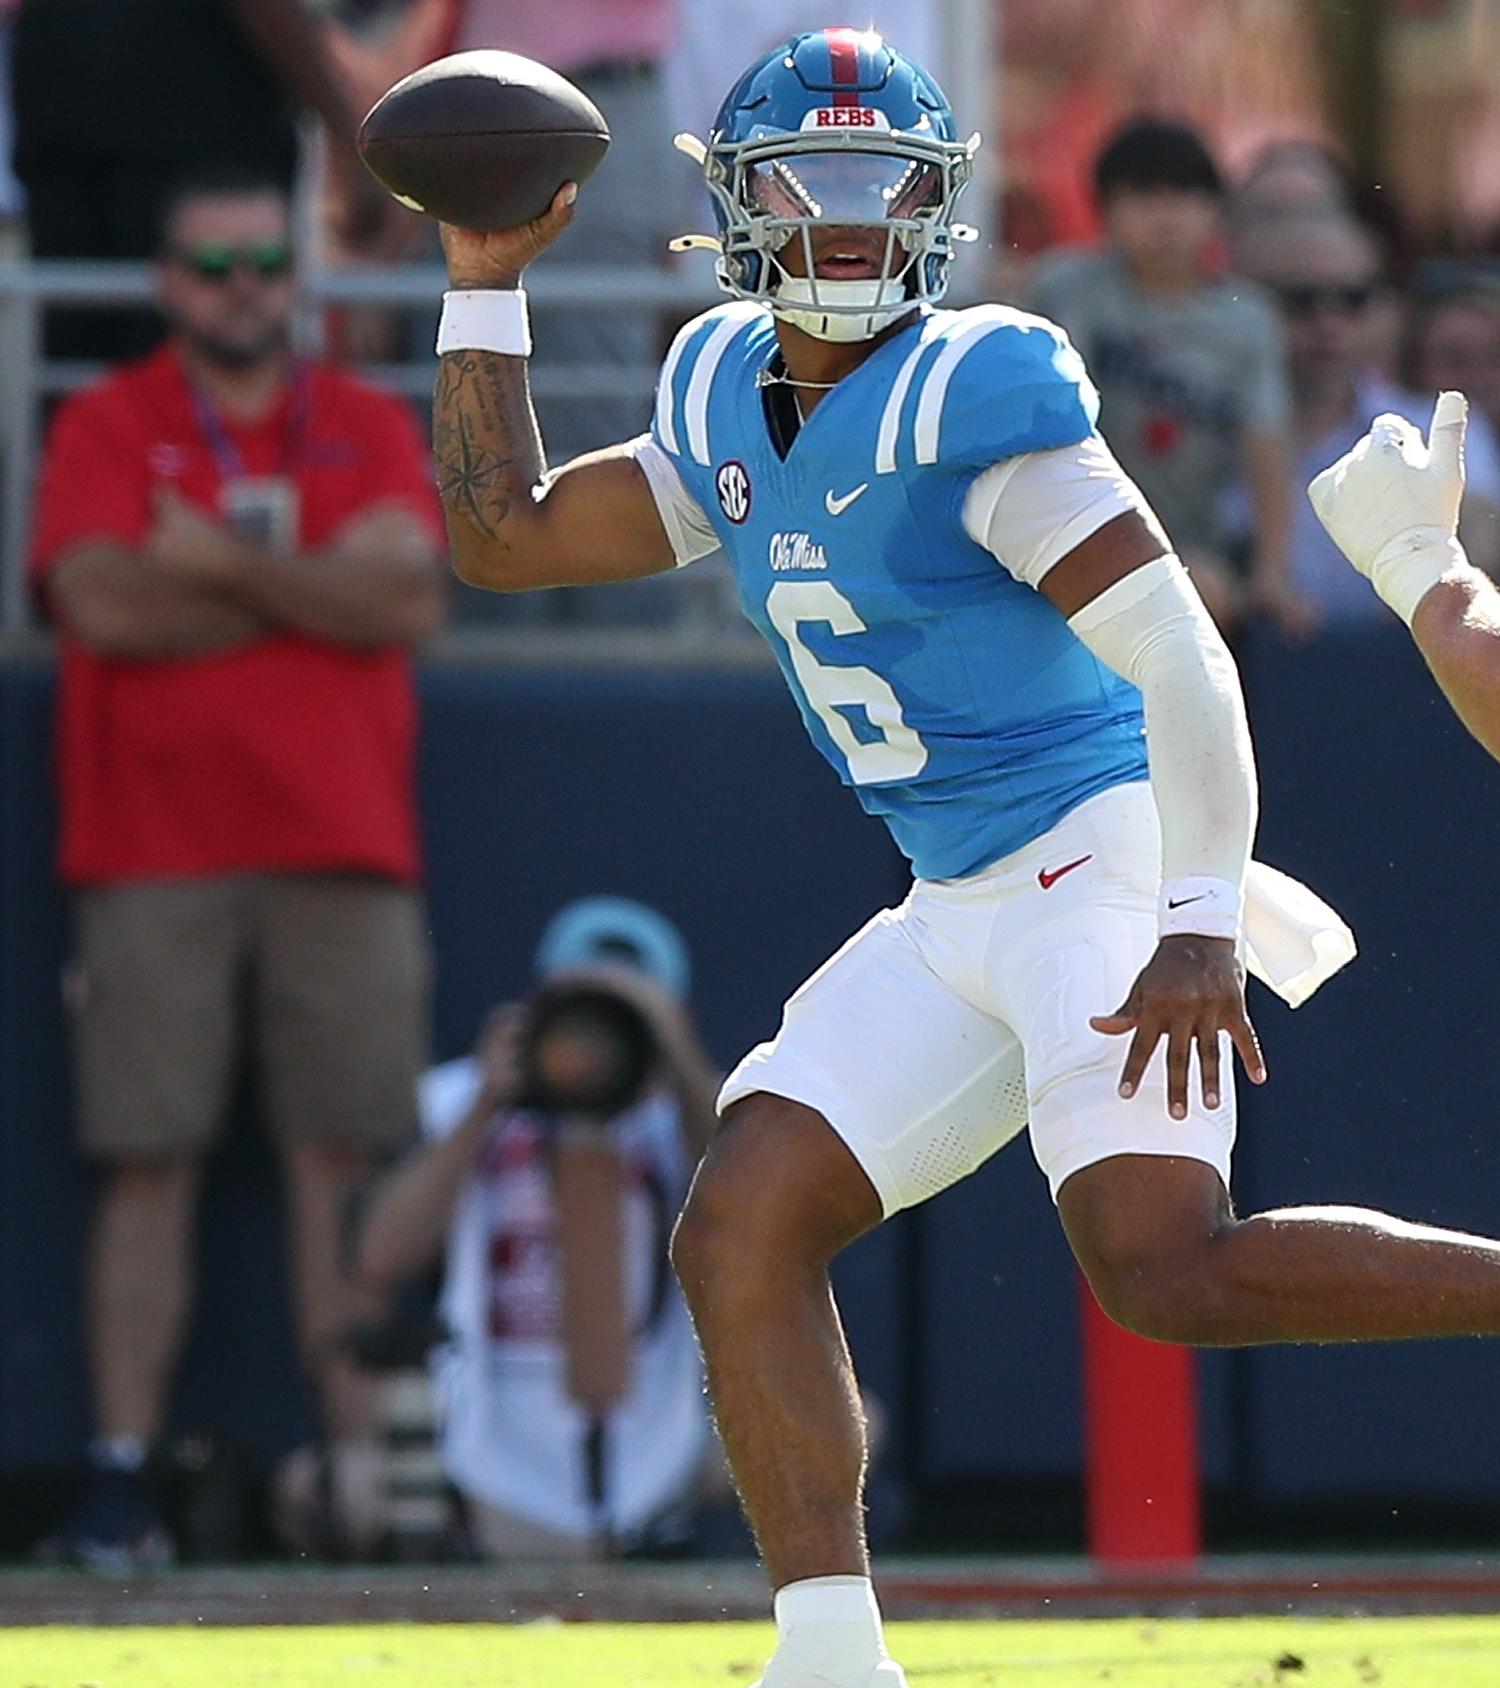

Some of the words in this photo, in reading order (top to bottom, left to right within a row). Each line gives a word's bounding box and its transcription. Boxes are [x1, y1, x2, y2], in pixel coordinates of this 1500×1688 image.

[816, 108, 876, 127] REBS
[718, 464, 749, 521] SEC
[789, 531, 828, 571] Miss
[765, 580, 928, 784] 6
